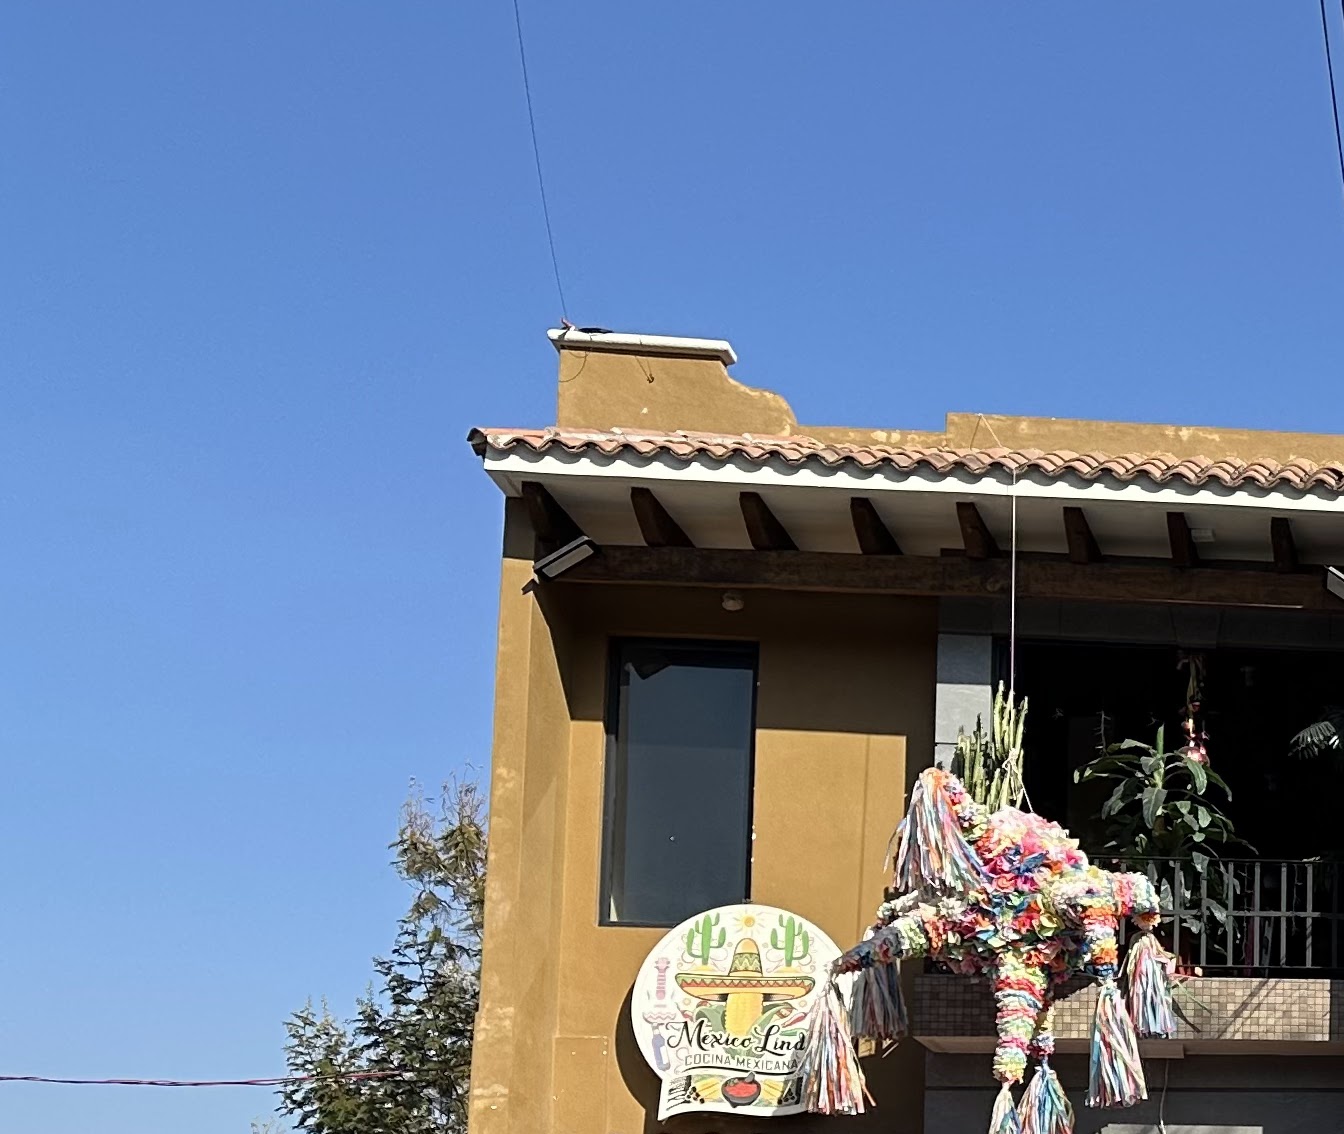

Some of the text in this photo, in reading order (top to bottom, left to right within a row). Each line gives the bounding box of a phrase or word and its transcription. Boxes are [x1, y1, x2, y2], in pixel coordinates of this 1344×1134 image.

[754, 1024, 806, 1056] Lind
[685, 1054, 799, 1071] COCINA MEXICANA
